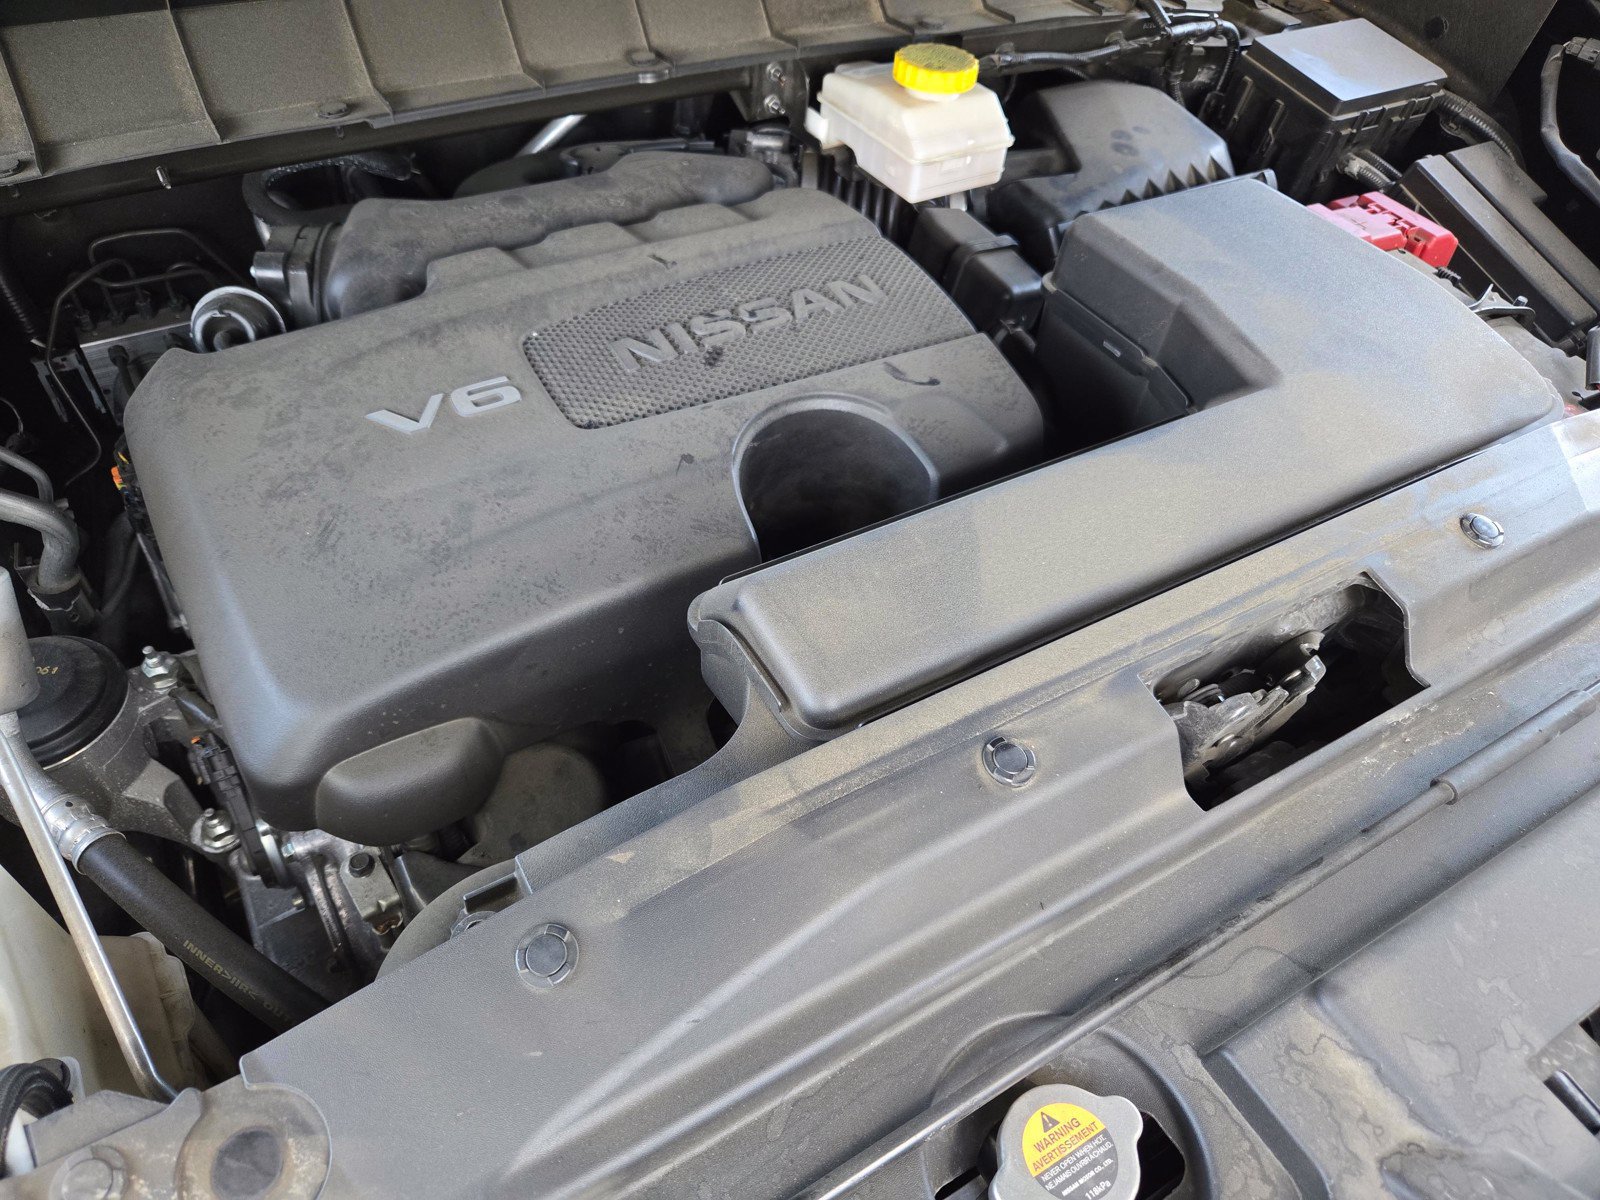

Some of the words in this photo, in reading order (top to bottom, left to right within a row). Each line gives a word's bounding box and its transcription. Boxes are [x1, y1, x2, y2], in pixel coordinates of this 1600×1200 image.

[607, 275, 888, 371] NISSAN
[365, 375, 522, 434] V6
[1032, 1121, 1099, 1172] AVERTISSEMENT
[1033, 1117, 1081, 1153] WARNING
[1041, 1165, 1061, 1182] NEVER
[1059, 1154, 1077, 1169] OPEN
[1075, 1143, 1094, 1159] WHEN
[1091, 1134, 1107, 1147] HOT.
[1084, 1179, 1112, 1200] 118kPa
